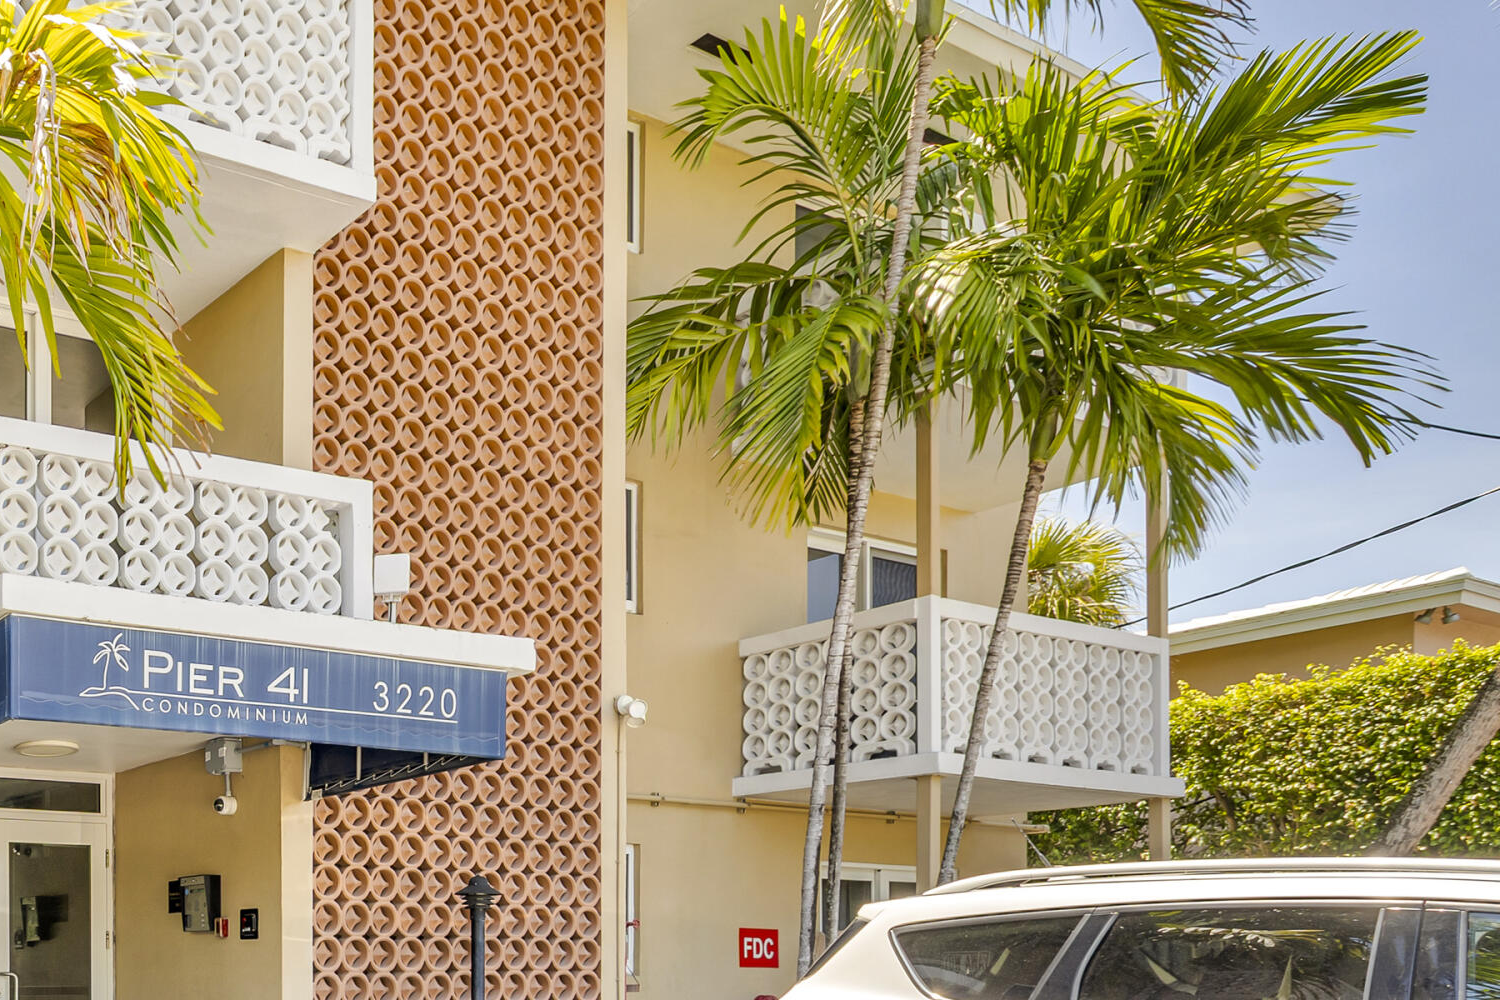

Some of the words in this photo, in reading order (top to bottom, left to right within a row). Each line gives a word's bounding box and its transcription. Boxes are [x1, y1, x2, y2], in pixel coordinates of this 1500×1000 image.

[143, 649, 246, 697] PIER
[267, 666, 309, 704] 41
[142, 696, 308, 726] CONDOMINIUM
[372, 680, 458, 719] 3220
[743, 936, 775, 960] FDC
